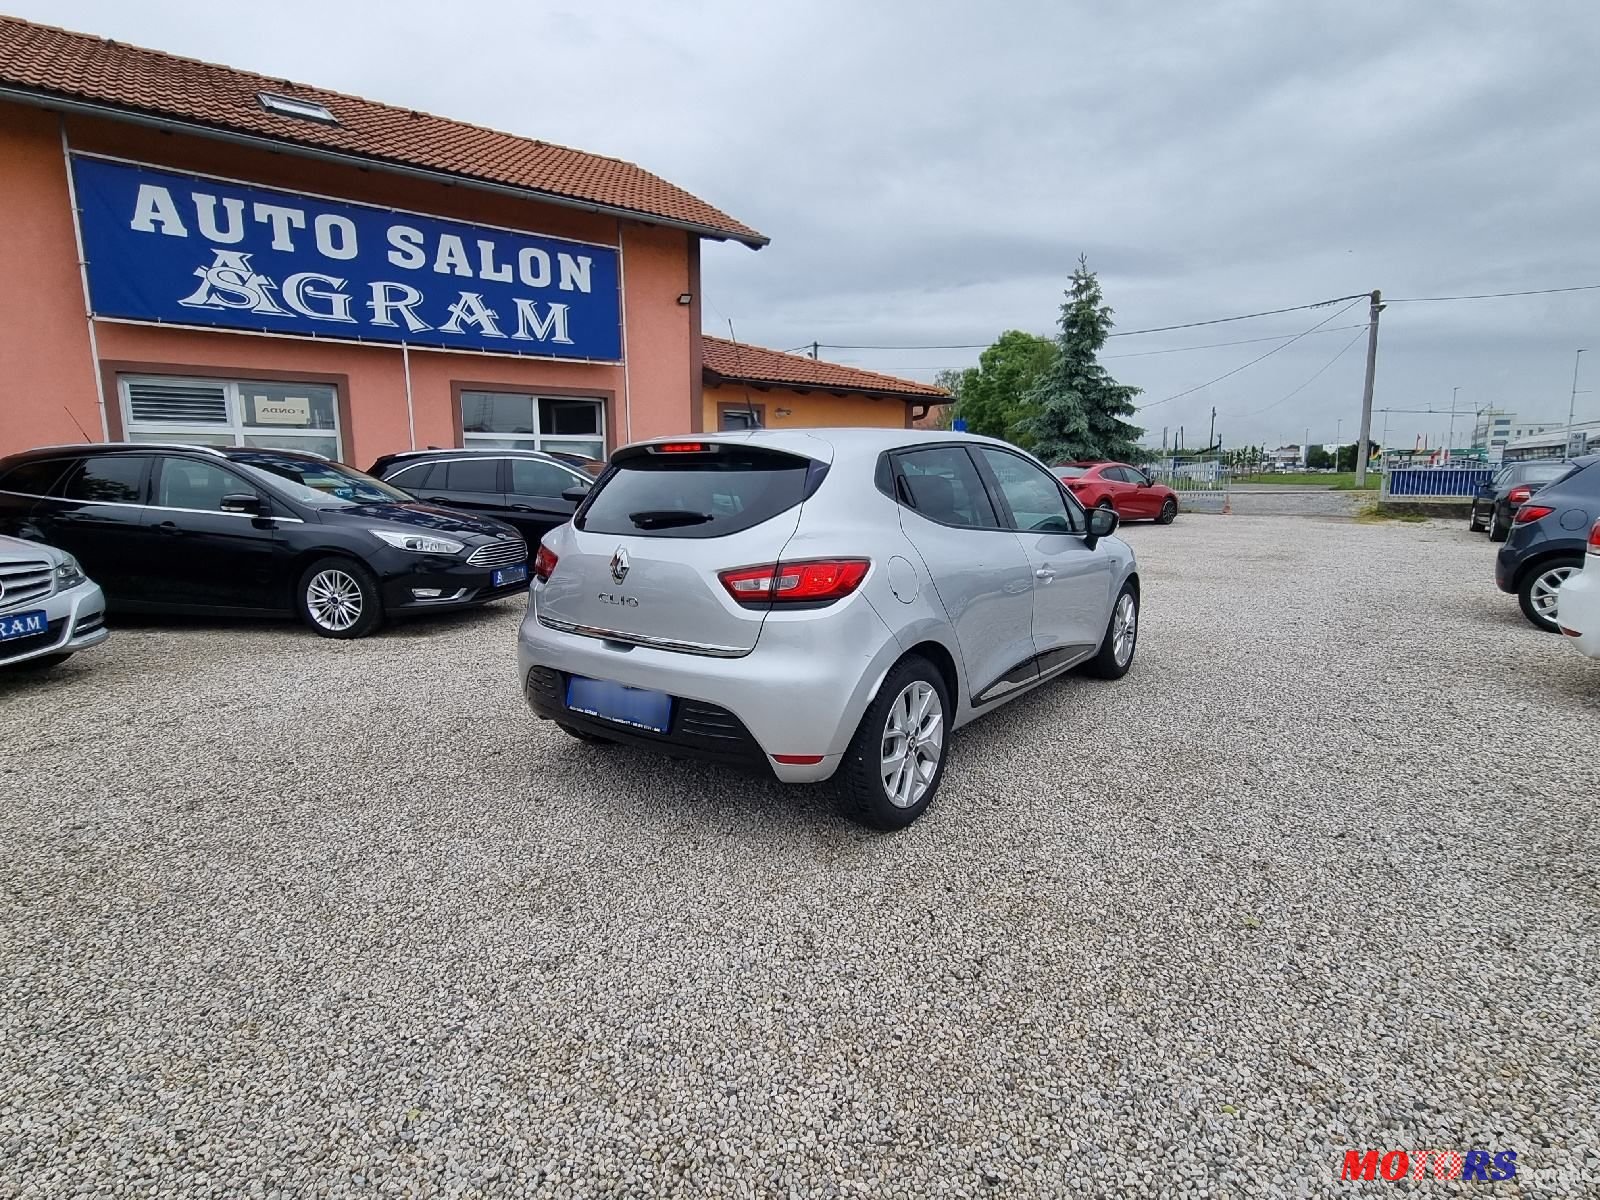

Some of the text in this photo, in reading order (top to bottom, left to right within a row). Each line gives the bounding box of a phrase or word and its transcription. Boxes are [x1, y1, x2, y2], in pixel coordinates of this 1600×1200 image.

[131, 184, 592, 293] AUTO SALON
[598, 592, 639, 608] CLIO
